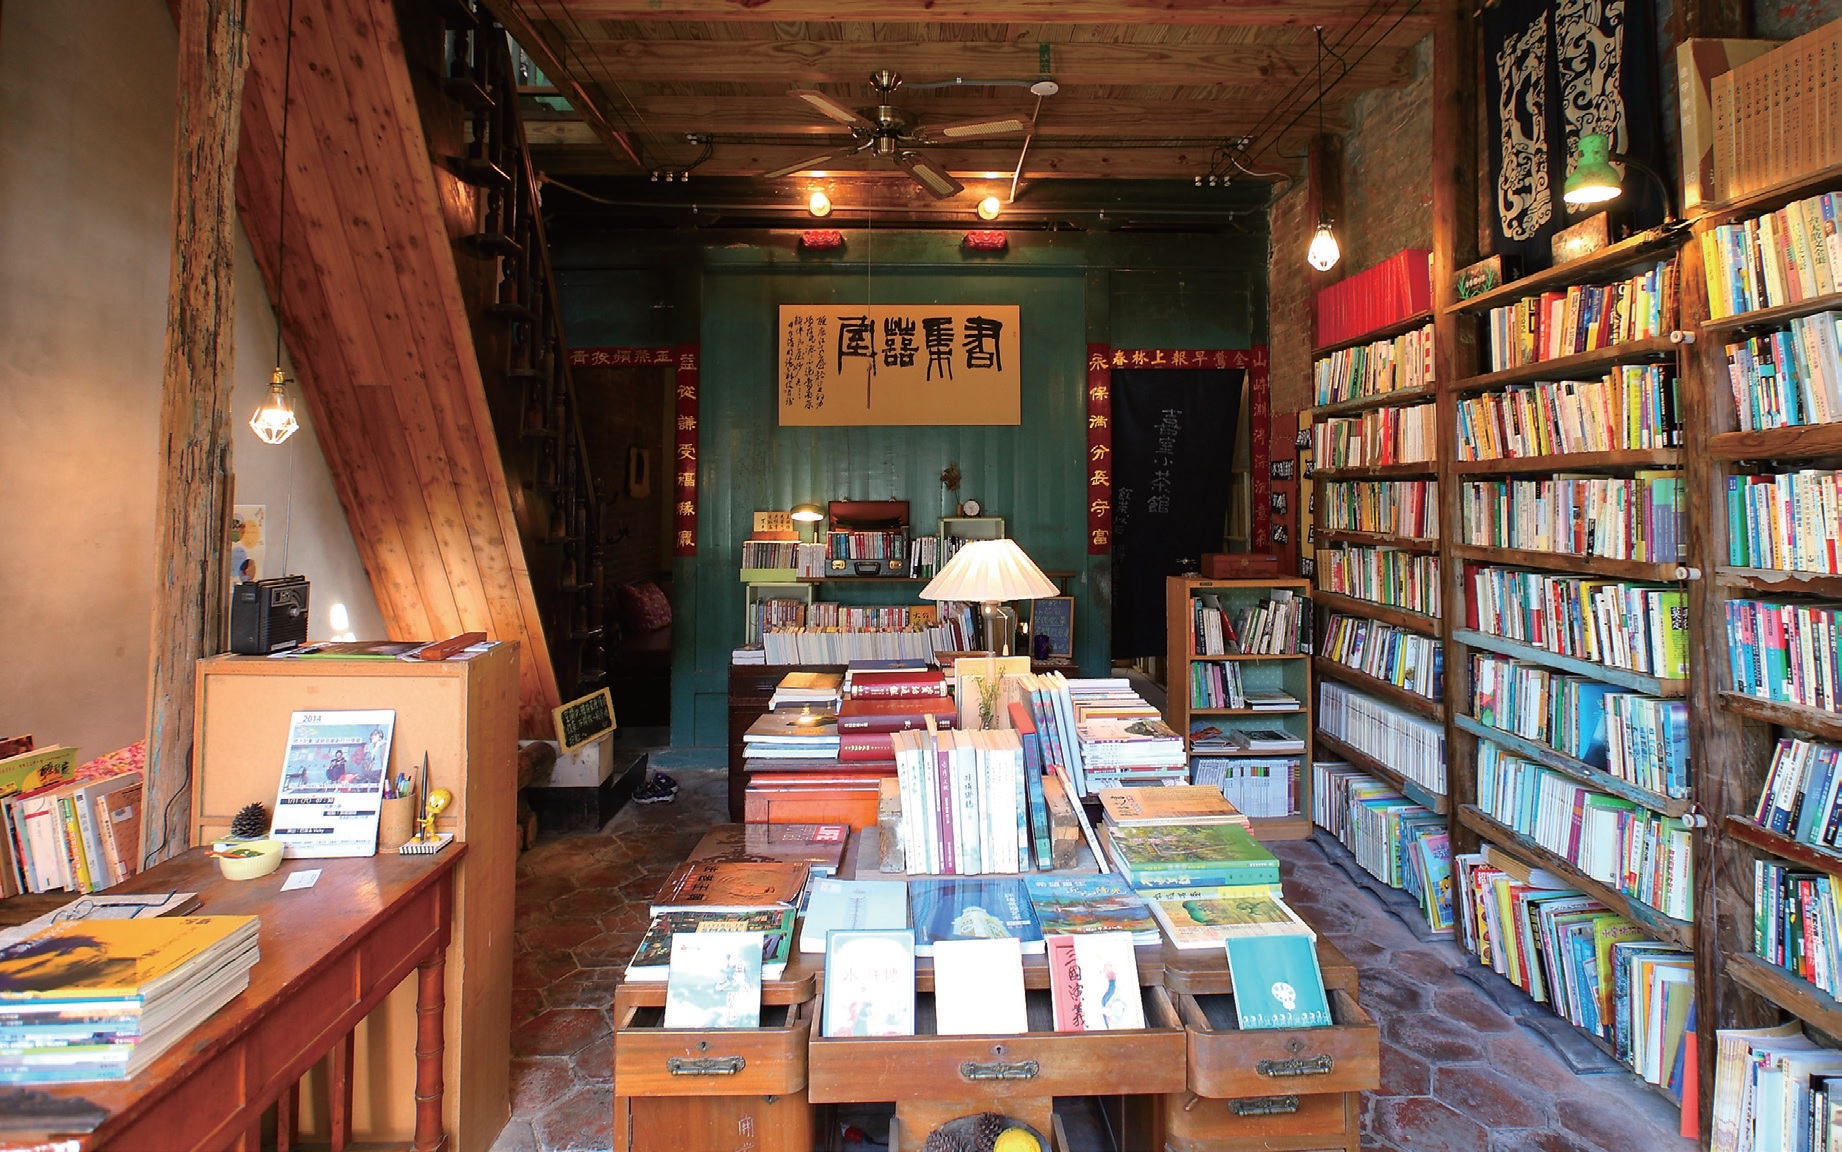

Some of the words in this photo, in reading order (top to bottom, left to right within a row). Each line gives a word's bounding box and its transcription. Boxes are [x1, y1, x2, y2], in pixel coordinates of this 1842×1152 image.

[302, 714, 322, 723] 2014
[1065, 949, 1089, 1029] 三國演義
